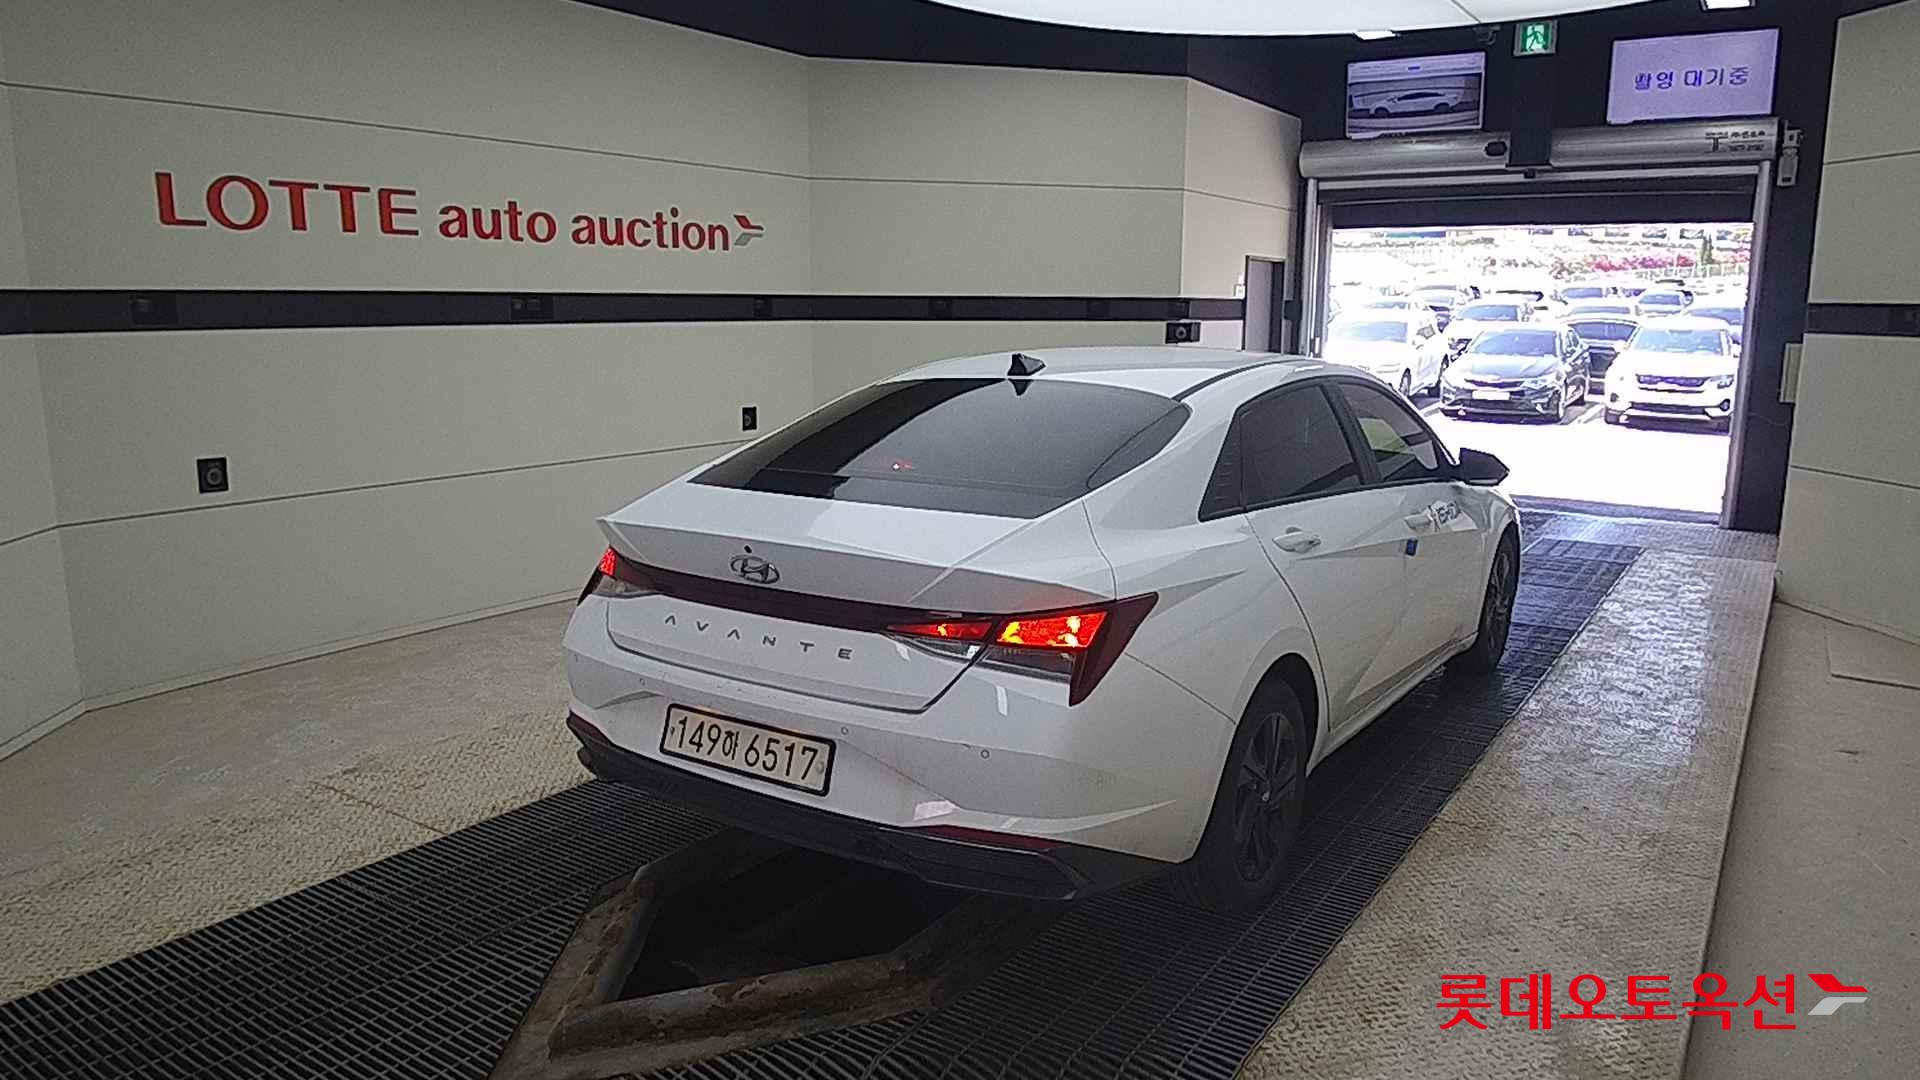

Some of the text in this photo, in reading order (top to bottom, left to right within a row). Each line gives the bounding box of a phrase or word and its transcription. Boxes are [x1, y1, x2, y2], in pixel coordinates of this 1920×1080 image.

[154, 172, 729, 252] LOTTE auto auction
[664, 614, 854, 661] AVANTE
[744, 732, 819, 782] 6517
